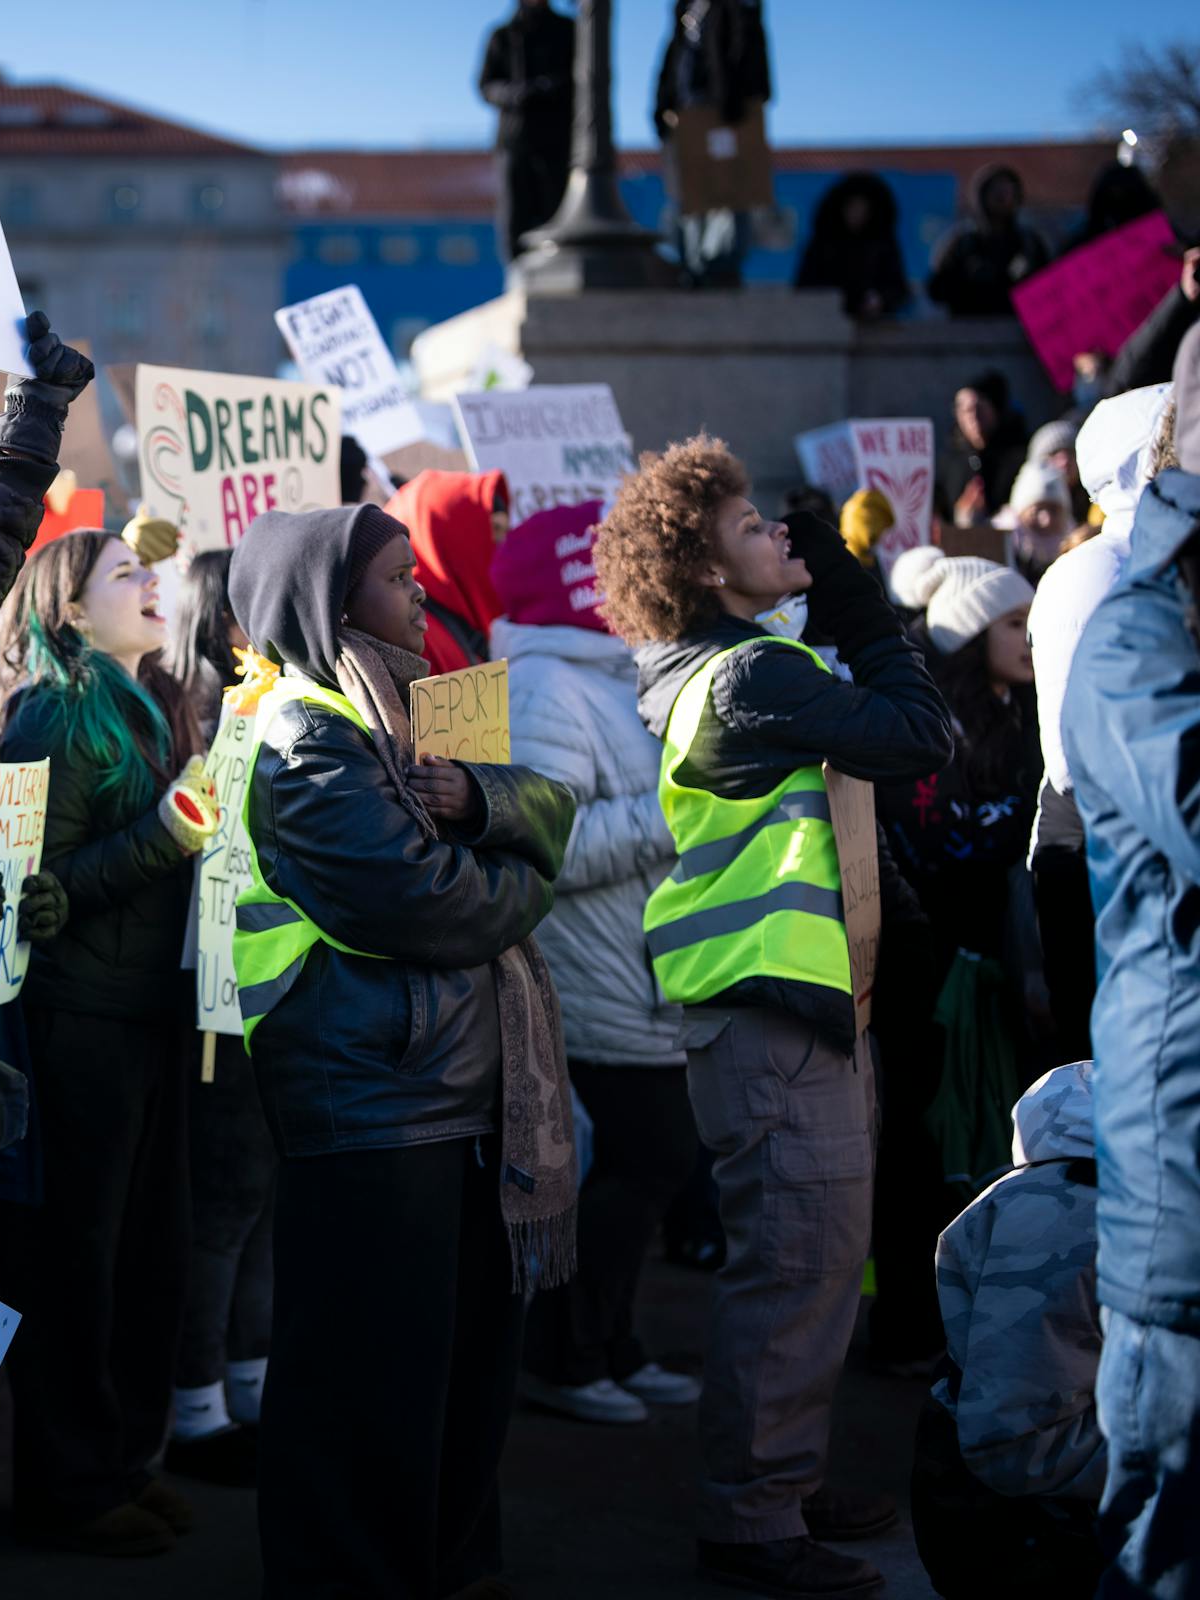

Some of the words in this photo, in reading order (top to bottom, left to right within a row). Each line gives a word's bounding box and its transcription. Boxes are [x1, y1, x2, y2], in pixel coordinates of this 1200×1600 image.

[323, 347, 380, 388] NOT
[184, 389, 330, 472] DREAMS
[856, 427, 889, 455] WE
[897, 427, 929, 455] ARE
[219, 474, 278, 545] ARE
[416, 670, 506, 741] DEPORT
